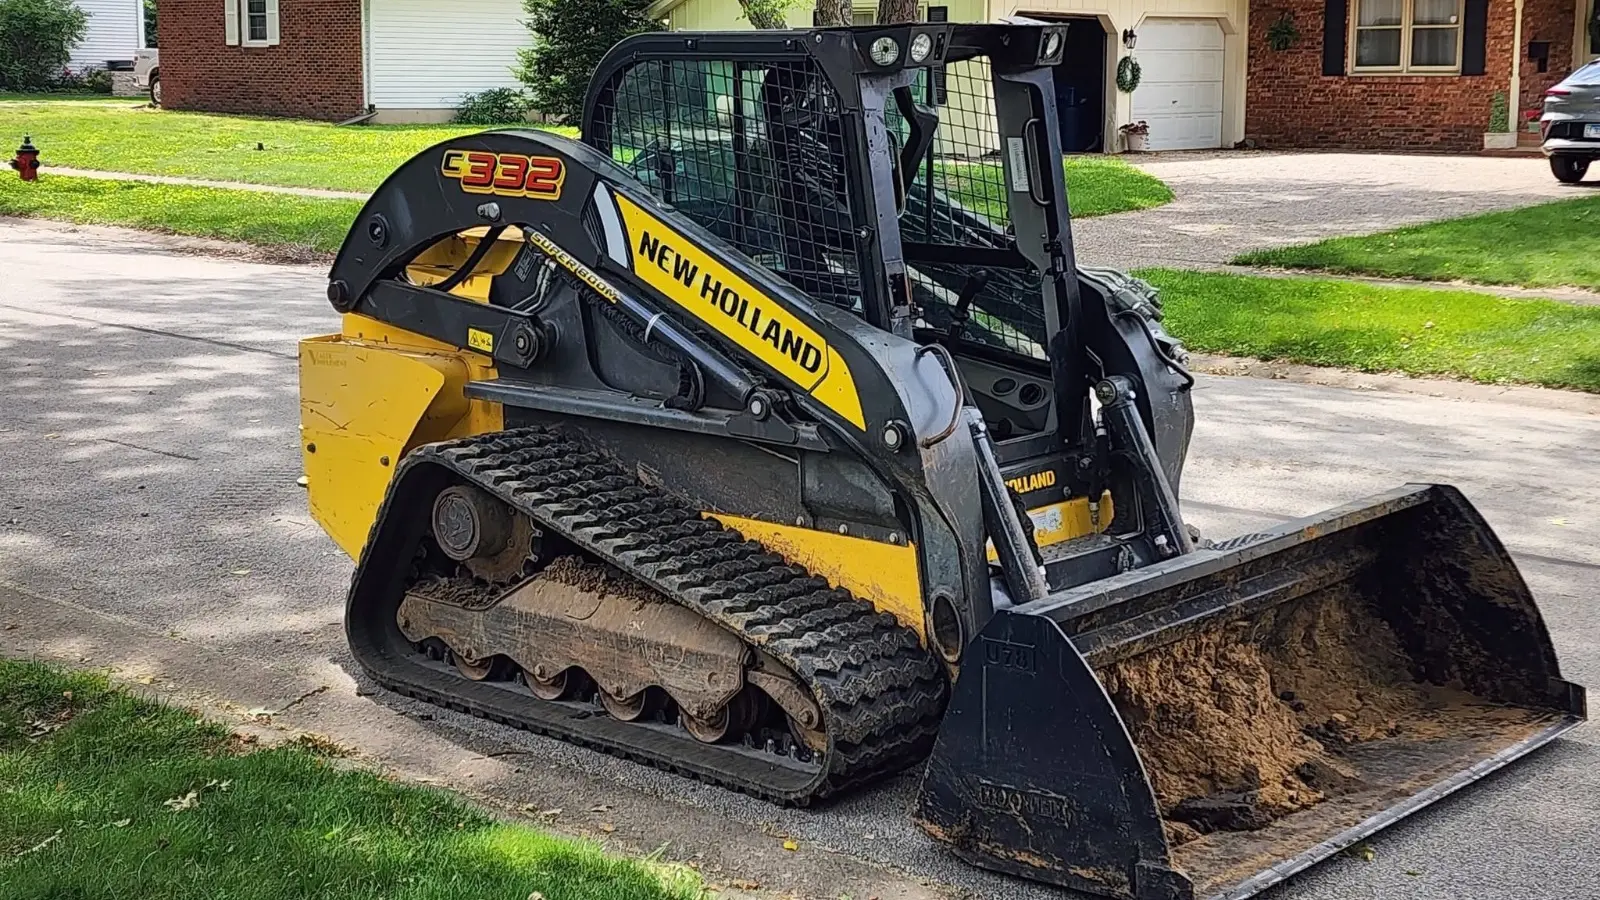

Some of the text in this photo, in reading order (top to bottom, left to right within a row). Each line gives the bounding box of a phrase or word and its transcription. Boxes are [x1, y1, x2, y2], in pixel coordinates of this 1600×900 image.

[639, 231, 822, 374] NEW HOLLAND
[1005, 470, 1055, 493] OLLAND
